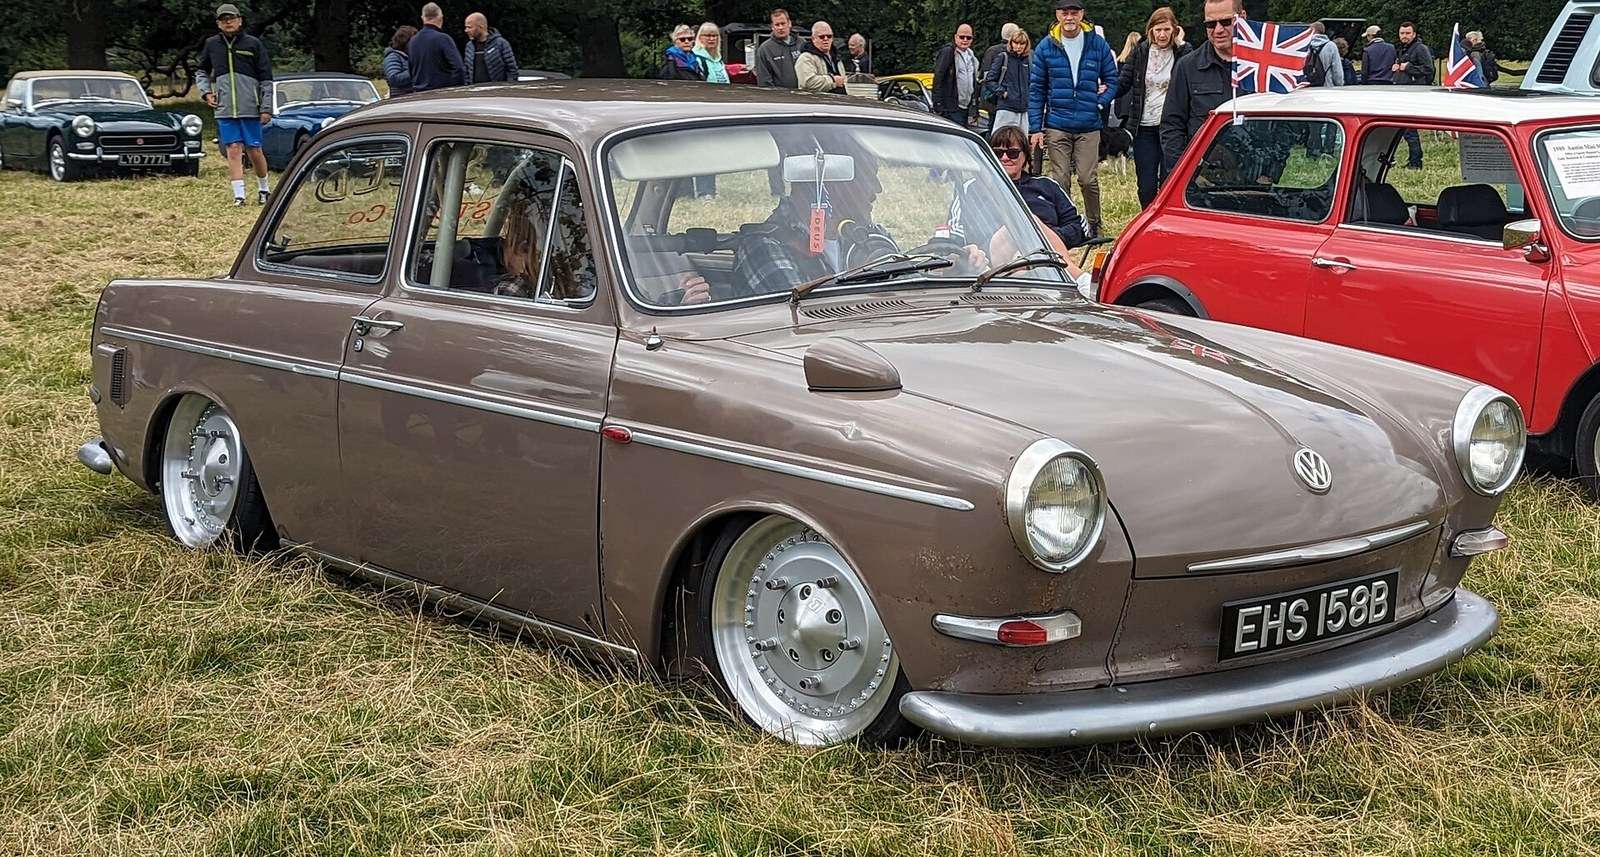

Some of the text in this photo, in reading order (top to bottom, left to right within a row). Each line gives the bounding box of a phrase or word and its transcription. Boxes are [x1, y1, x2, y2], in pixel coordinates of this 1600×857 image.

[119, 153, 169, 164] LYD 777L
[1294, 449, 1332, 489] VW
[1235, 580, 1389, 653] EHS 158B
